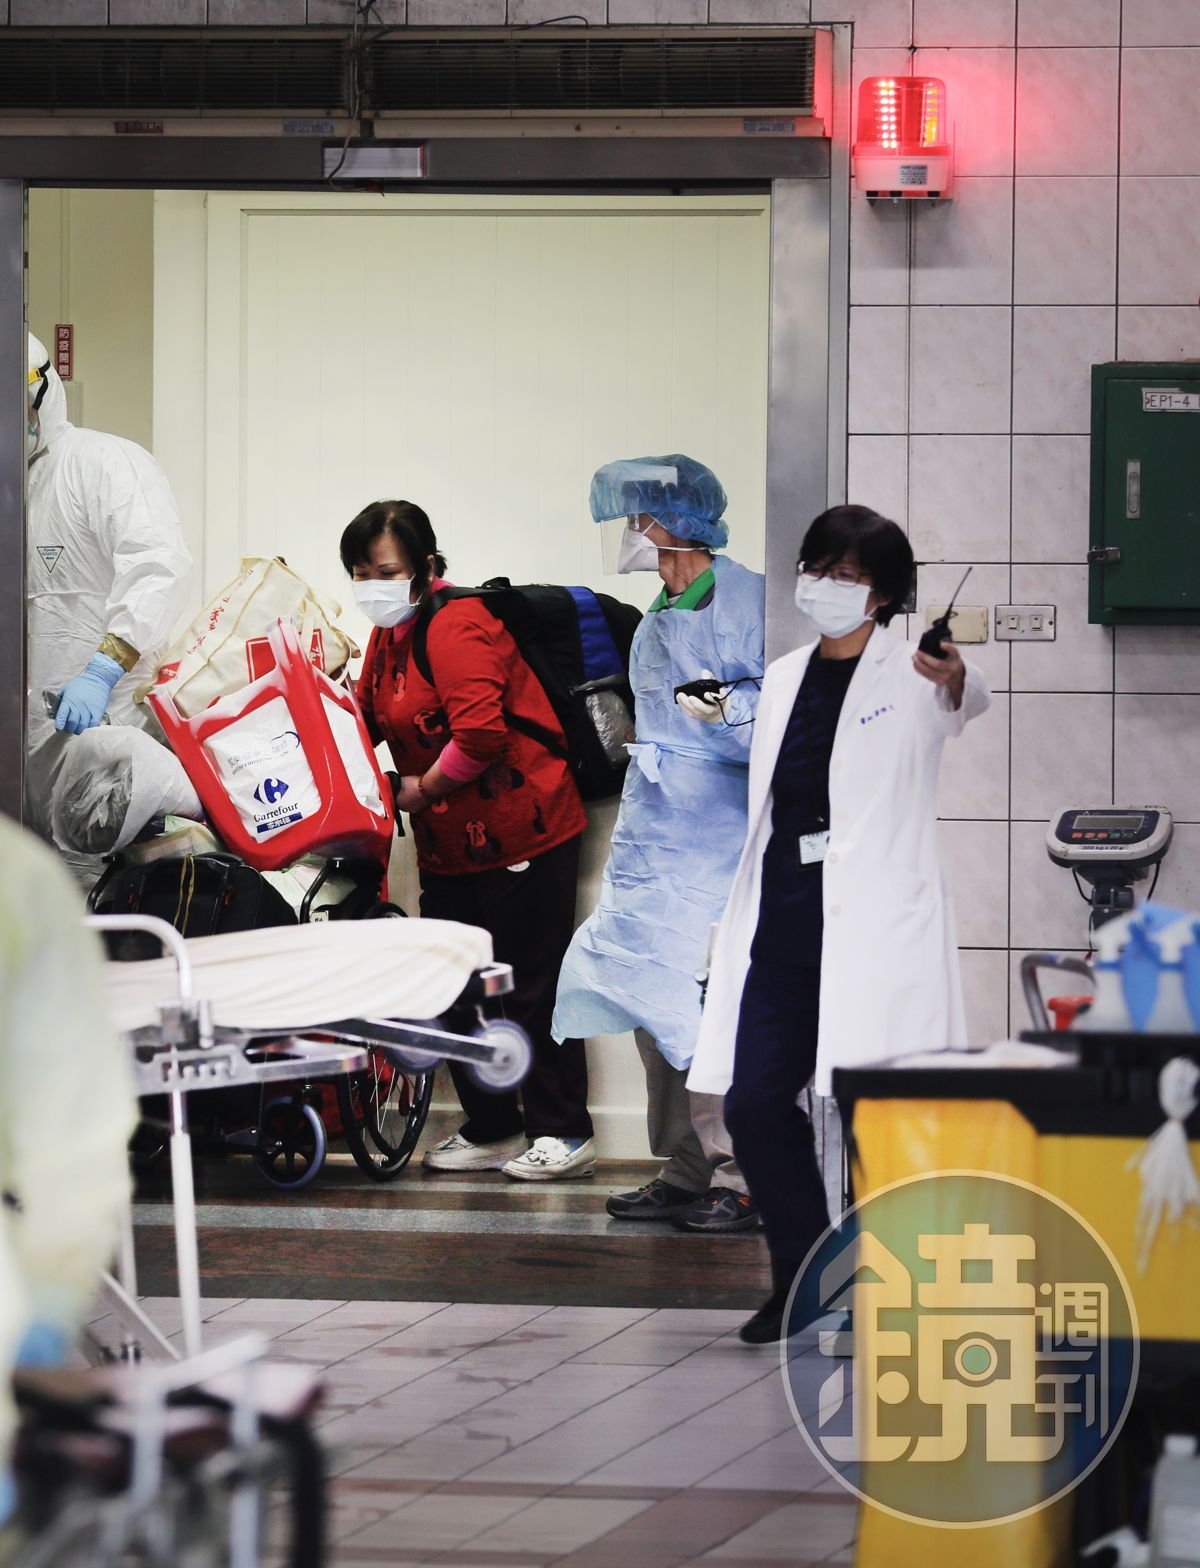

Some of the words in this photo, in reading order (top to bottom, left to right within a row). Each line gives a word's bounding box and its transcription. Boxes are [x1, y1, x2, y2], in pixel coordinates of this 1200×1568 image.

[59, 328, 70, 375] 防疫開關
[253, 802, 299, 822] Carrefour
